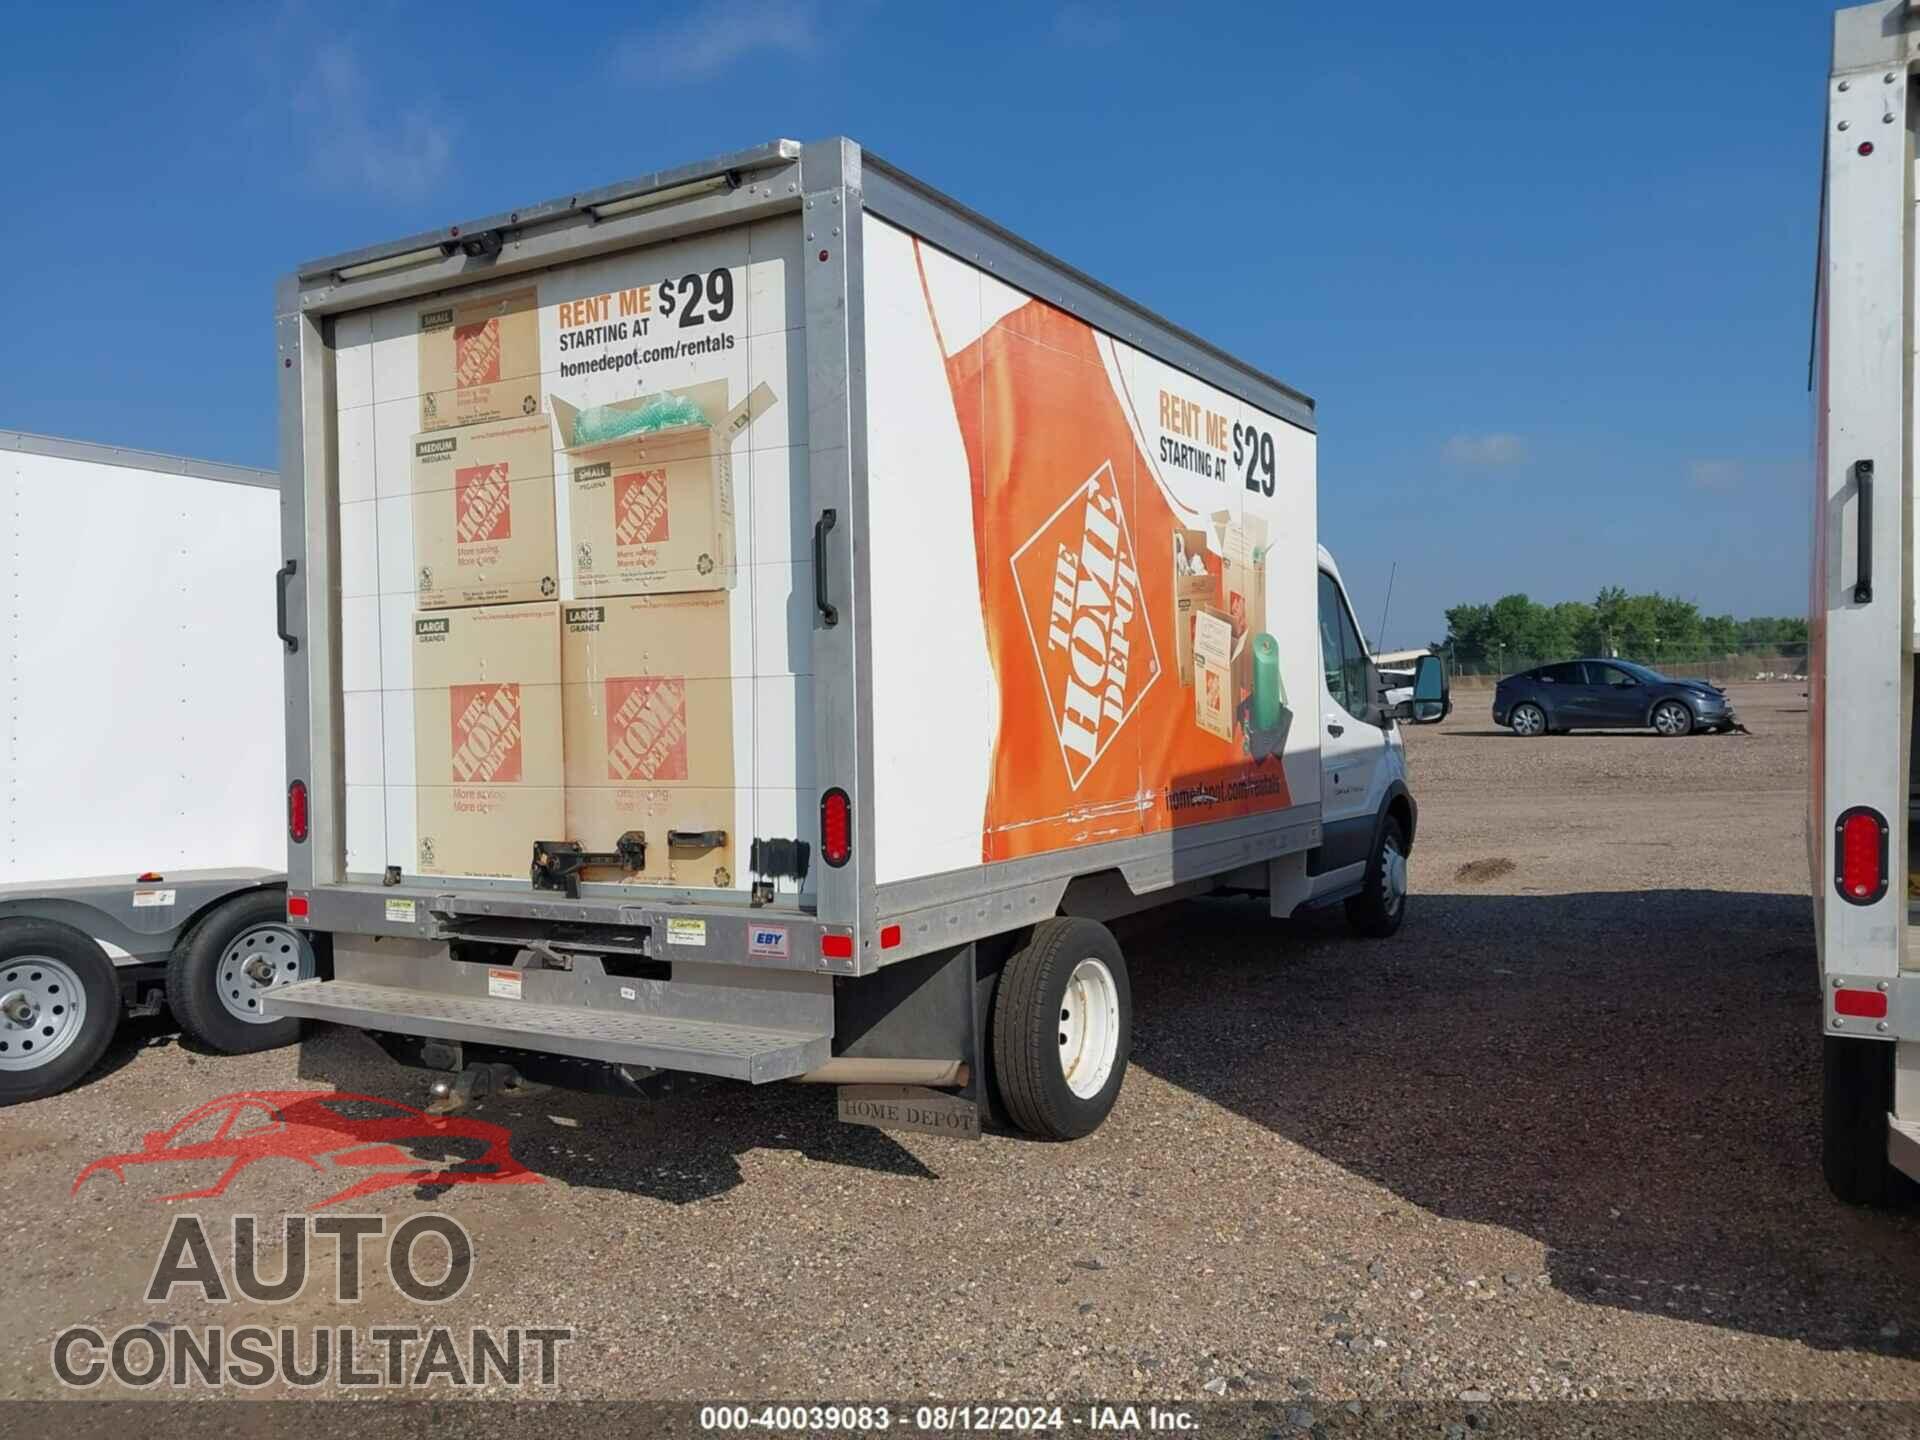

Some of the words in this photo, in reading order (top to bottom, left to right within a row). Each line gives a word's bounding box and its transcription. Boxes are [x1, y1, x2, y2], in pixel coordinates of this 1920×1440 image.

[559, 294, 611, 329] RENT
[619, 287, 652, 317] ME
[658, 267, 735, 328] $29
[457, 318, 499, 386] HOME
[559, 322, 627, 351] STARTING
[632, 318, 650, 338] AT
[560, 332, 735, 377] homedepot.com/rentals
[420, 440, 453, 454] MEDIUM
[1160, 390, 1201, 441] RENT
[1206, 409, 1228, 453] ME
[1232, 418, 1275, 498] $29
[1160, 435, 1212, 478] STARTING
[1215, 456, 1227, 482] AT
[457, 464, 507, 543] HOME
[463, 472, 483, 504] THE
[616, 470, 667, 545] HOME
[621, 480, 641, 510] THE
[478, 490, 510, 541] DEPOT
[636, 495, 668, 544] DEPOT
[569, 610, 601, 622] LARGE
[1047, 543, 1079, 652] THE
[1061, 478, 1121, 764] HOME
[419, 621, 446, 633] LARGE
[1103, 551, 1137, 726] DEPOT
[453, 683, 520, 782] HOME
[457, 691, 487, 733] THE
[608, 681, 684, 780] HOME
[613, 687, 647, 729] THE
[479, 719, 521, 782] DEPOT
[638, 713, 688, 781] DEPOT
[757, 932, 783, 945] EBY
[845, 1100, 899, 1121] HOME
[906, 1108, 972, 1130] DEPOT
